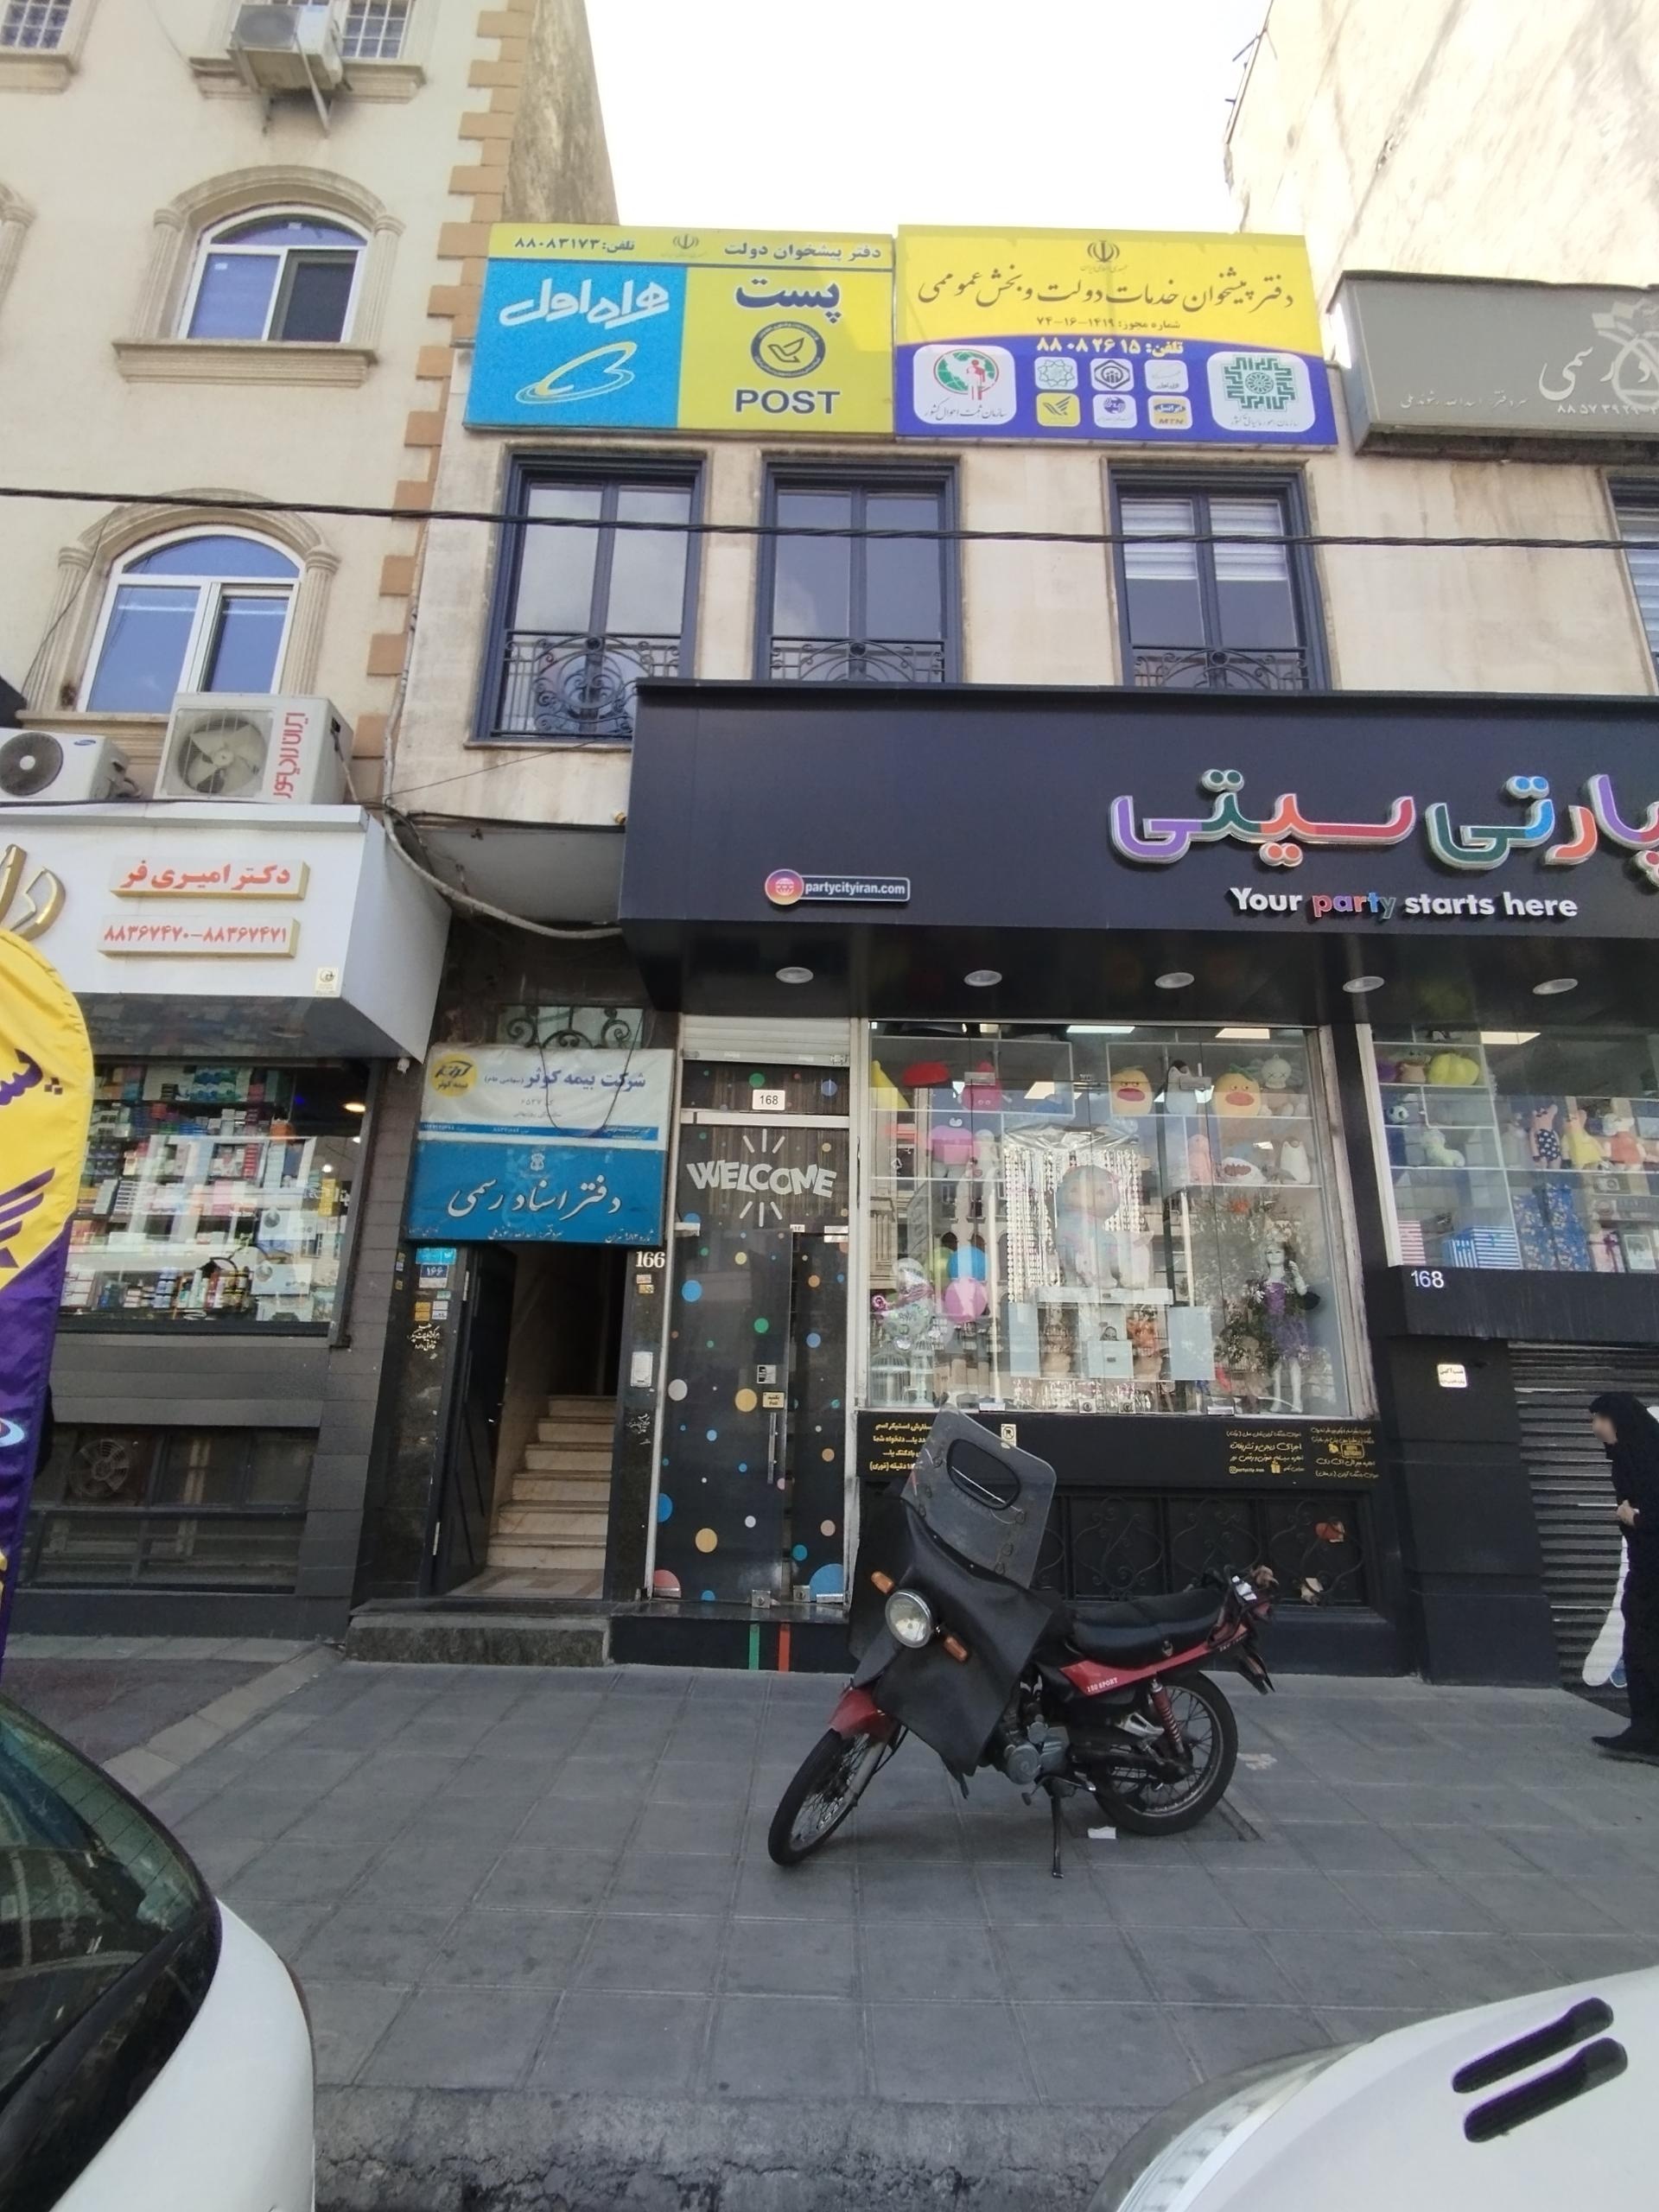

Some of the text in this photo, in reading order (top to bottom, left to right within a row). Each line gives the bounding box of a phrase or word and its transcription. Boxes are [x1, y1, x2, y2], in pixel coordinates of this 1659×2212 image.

[514, 237, 601, 250] ۸۸۰۸۳۱۷۳
[724, 242, 768, 259] دولت
[772, 243, 842, 261] پیشخوان
[849, 245, 881, 262] دفتر
[918, 269, 982, 304] عمومی
[975, 264, 1024, 308] بخش
[1038, 283, 1103, 304] دولت
[1105, 282, 1179, 307] خدمات
[1182, 266, 1255, 313] پیشخوان
[1249, 274, 1294, 314] دفتر
[499, 277, 669, 330] همراه اول
[734, 276, 842, 325] پست
[1151, 320, 1181, 331] شماره
[1145, 340, 1185, 358] تلفن:
[734, 388, 841, 416] POST
[282, 711, 309, 745] ایران
[1108, 767, 1416, 866] سیتی
[119, 859, 291, 891] دکتر امیری فر
[804, 880, 906, 896] partycityiran.com
[1230, 886, 1580, 921] Your party starts here
[523, 1066, 562, 1090] کوثر
[563, 1073, 596, 1090] بیمه
[601, 1071, 646, 1092] شرکت
[760, 1094, 779, 1106] 168
[686, 1159, 837, 1198] WELCOME
[447, 1174, 621, 1221] دفتر اسناد رسمی
[635, 1250, 665, 1268] 166
[1411, 1269, 1445, 1289] 168
